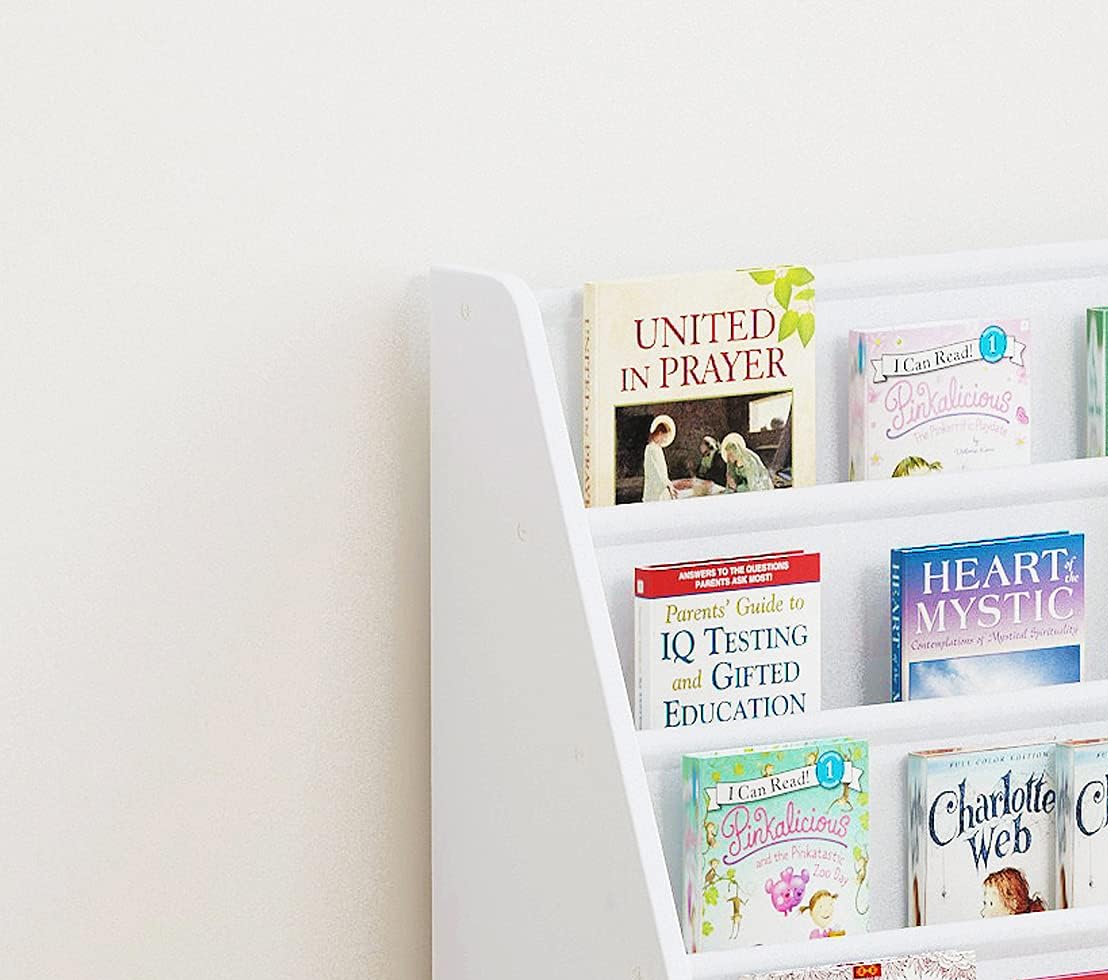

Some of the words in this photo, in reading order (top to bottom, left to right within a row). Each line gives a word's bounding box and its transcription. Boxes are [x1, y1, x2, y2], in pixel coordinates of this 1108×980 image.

[635, 308, 777, 350] UNITED
[987, 335, 997, 354] 1
[620, 366, 651, 392] IN
[659, 347, 788, 389] PRAYER
[893, 358, 900, 373] I
[903, 357, 931, 371] Can
[934, 344, 974, 365] Read!
[885, 376, 1012, 430] Pinkalicious
[679, 568, 717, 580] ANSWERS
[717, 567, 729, 576] TO
[729, 565, 745, 575] THE
[746, 561, 789, 573] QUESTIONS
[923, 548, 1068, 594] HEART
[1064, 556, 1076, 573] of
[1065, 571, 1079, 583] the
[695, 577, 730, 589] PARENTS
[732, 575, 748, 585] ASK
[748, 573, 773, 583] MOST!
[665, 599, 729, 624] Parents'
[736, 593, 783, 617] Guide
[790, 597, 805, 611] to
[916, 587, 1074, 634] MYSTIC
[660, 630, 696, 664] IQ
[704, 624, 808, 656] TESTING
[910, 636, 974, 651] Contemplations
[988, 628, 1028, 645] Mystical
[1030, 624, 1079, 641] Spirituality
[672, 669, 702, 691] and
[712, 661, 800, 690] GIFTED
[664, 693, 806, 728] EDUCATION
[825, 760, 834, 778] 1
[728, 786, 734, 801] I
[738, 784, 767, 799] Can
[770, 771, 810, 792] Read!
[928, 769, 1056, 847] Charlotte
[721, 801, 851, 857] Pinkalicious
[967, 813, 1032, 872] Web
